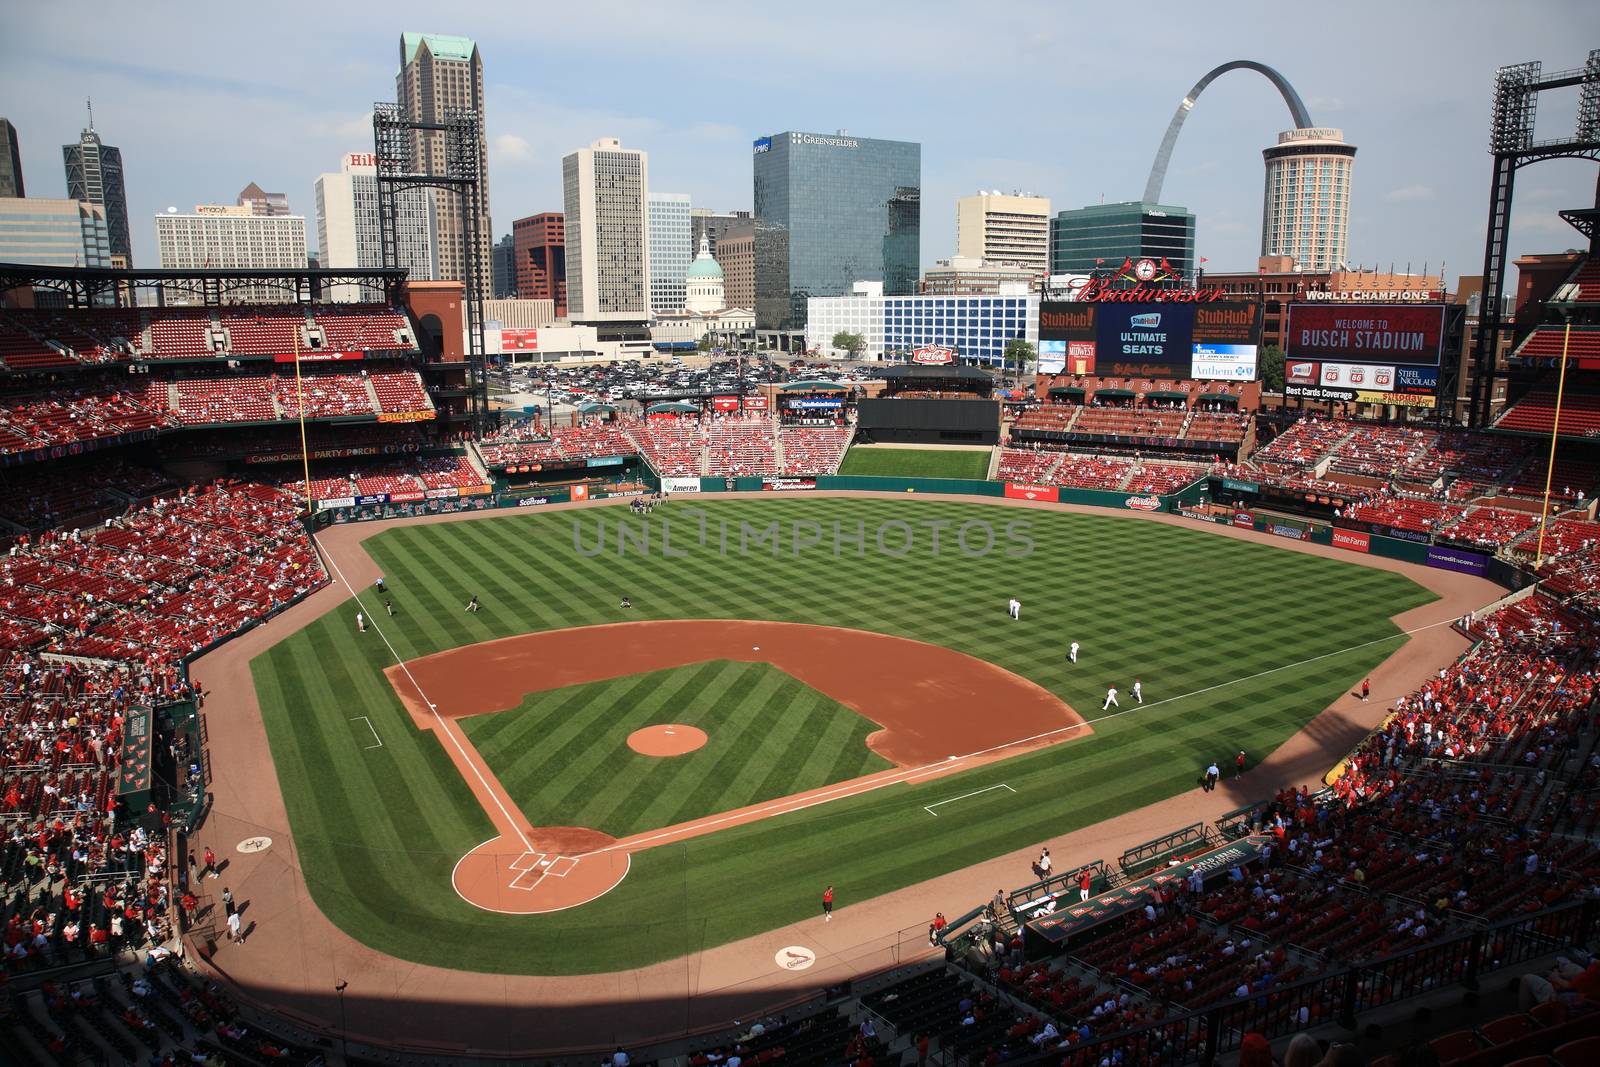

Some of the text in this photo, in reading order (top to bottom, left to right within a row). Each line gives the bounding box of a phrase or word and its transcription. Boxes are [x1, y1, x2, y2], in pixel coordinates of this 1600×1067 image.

[1291, 129, 1337, 137] MILLENNIUM
[803, 135, 858, 148] GREENSFELDER
[1068, 277, 1226, 302] Budweiser
[1306, 291, 1430, 300] WORLD CHAMPIONS
[1041, 307, 1094, 327] StubHub!
[1197, 304, 1255, 325] StubHub!
[1132, 316, 1159, 325] StubHub!
[1335, 319, 1388, 330] WELCOME TO
[1121, 333, 1167, 342] ULTIMATE
[1302, 330, 1425, 351] BUSCH STADIUM
[1069, 347, 1096, 356] MIDWEST
[1123, 345, 1164, 355] SEATS
[1195, 366, 1233, 376] Anthem
[1398, 369, 1420, 378] STIFEL
[1400, 377, 1437, 387] NICOLAUS
[1286, 386, 1353, 400] Best Cards Coverage
[315, 450, 343, 459] PARTY
[673, 485, 698, 493] Ameren
[1390, 528, 1428, 544] Keep Going
